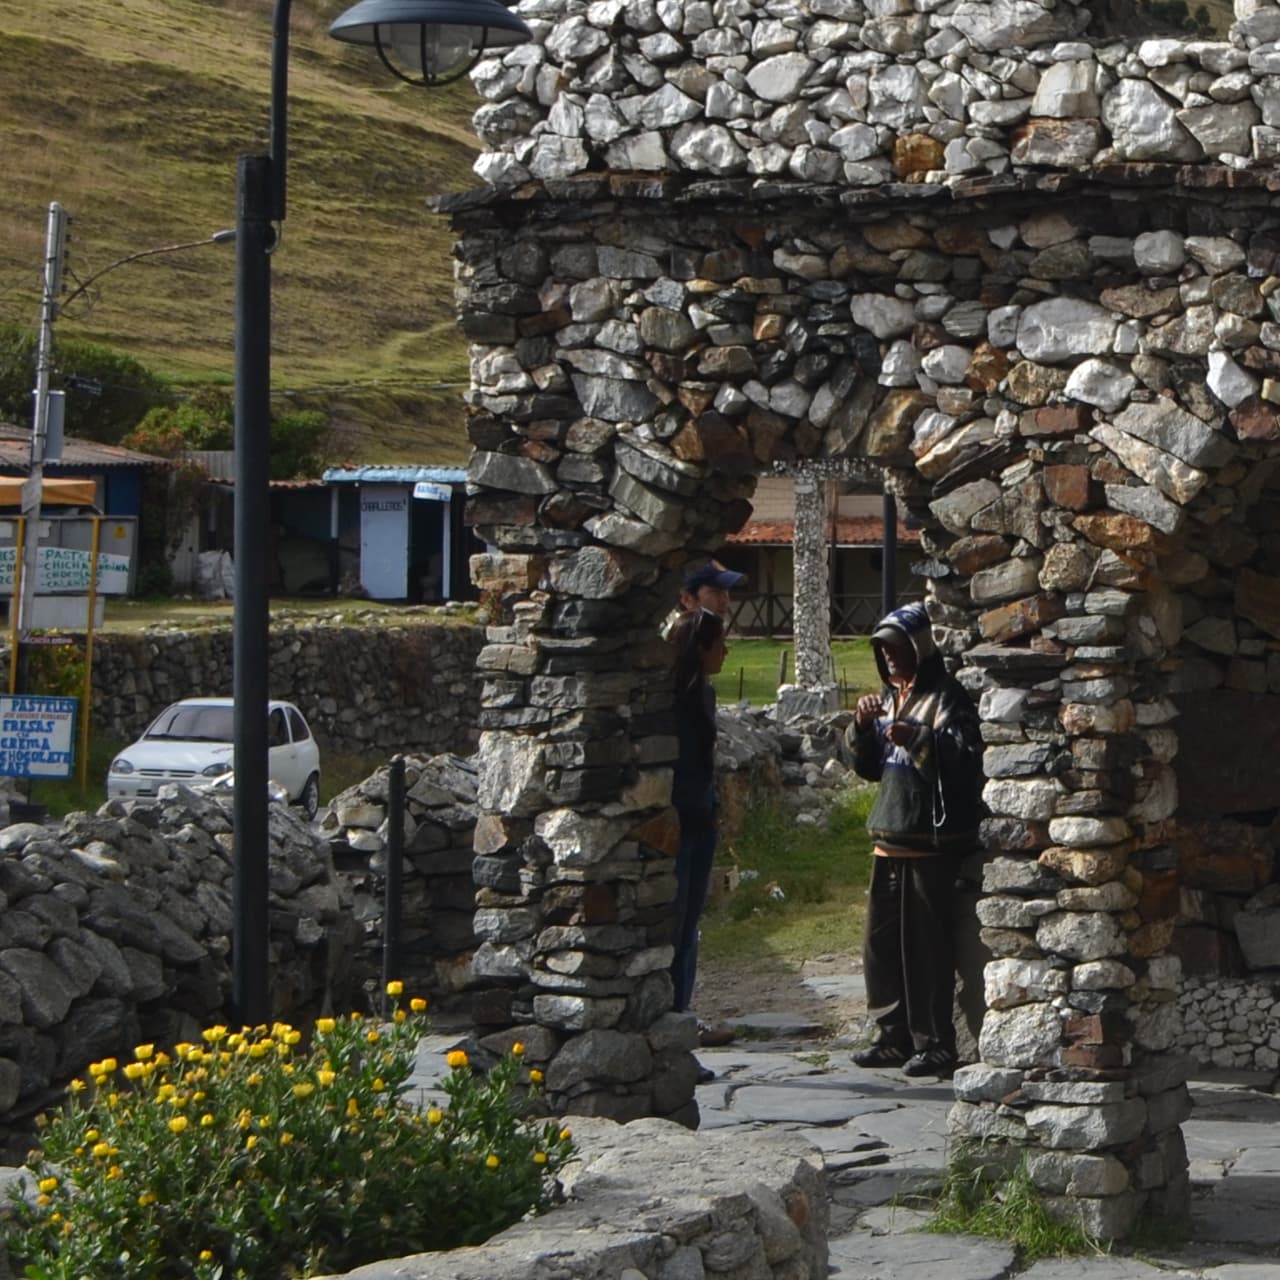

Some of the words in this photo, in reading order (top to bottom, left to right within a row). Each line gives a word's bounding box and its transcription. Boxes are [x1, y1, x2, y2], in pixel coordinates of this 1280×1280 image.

[12, 700, 74, 713] PASTELES
[3, 720, 55, 733] FRESAS
[1, 738, 50, 749] CREMA
